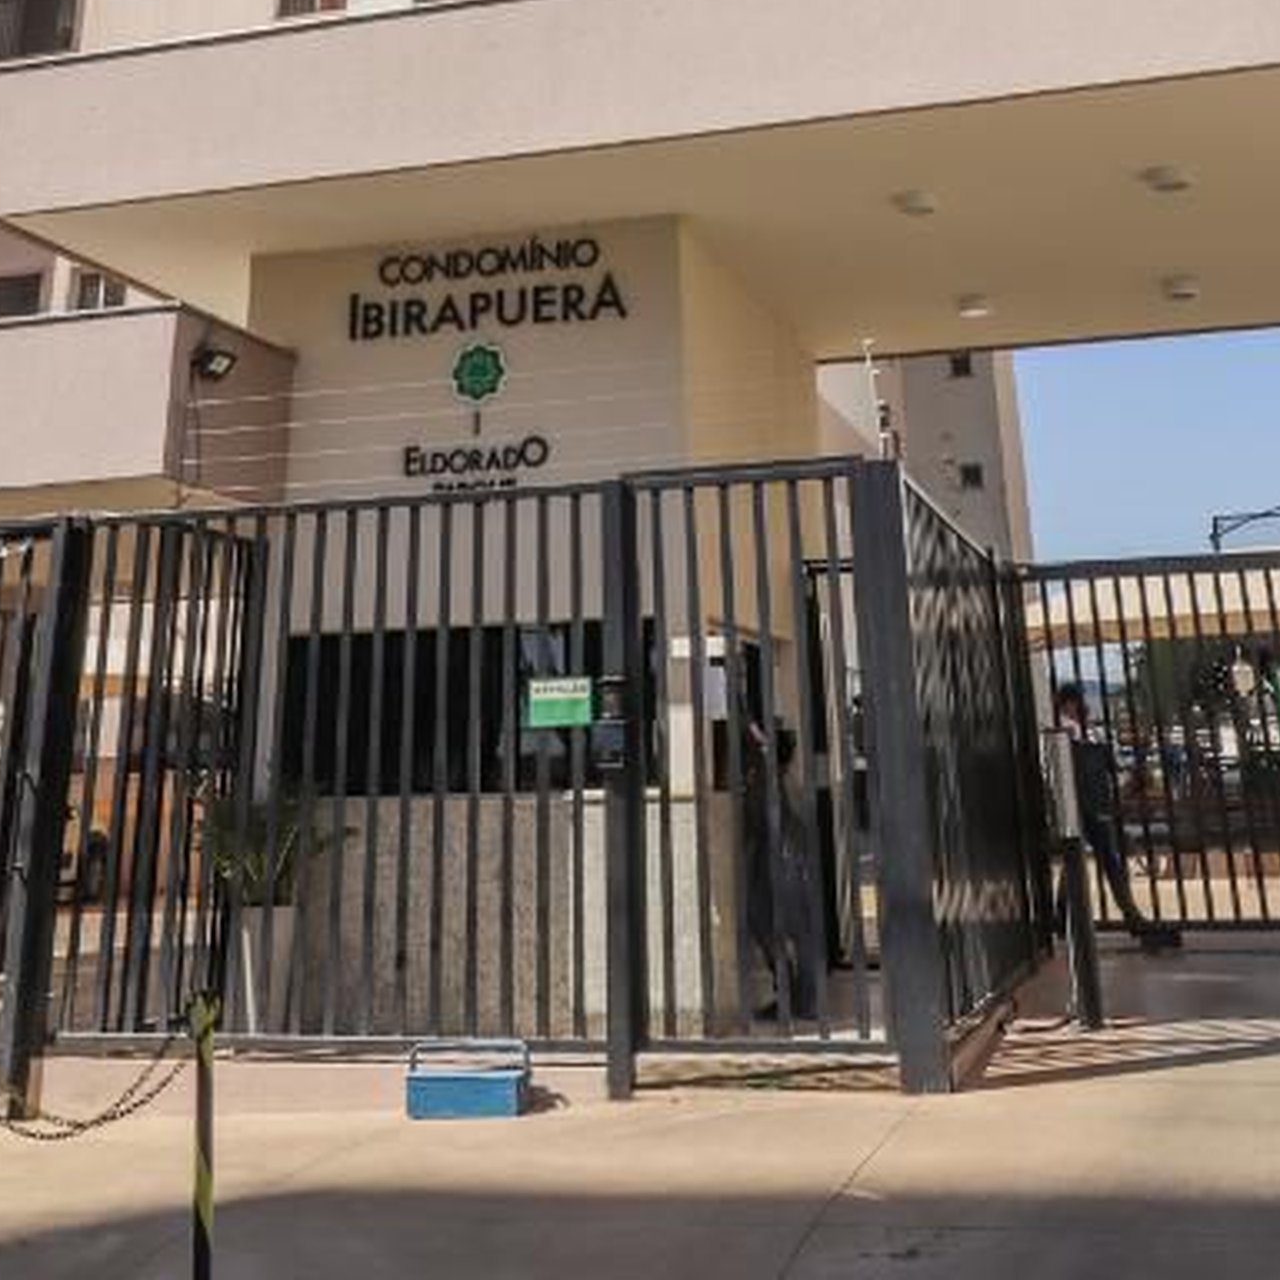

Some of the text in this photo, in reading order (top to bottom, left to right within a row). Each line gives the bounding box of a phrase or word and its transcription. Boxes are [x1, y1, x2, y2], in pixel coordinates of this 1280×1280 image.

[378, 235, 600, 288] CONDOMÍNIO
[348, 272, 627, 341] IBIRAPUERA
[404, 435, 549, 477] ELDORADO
